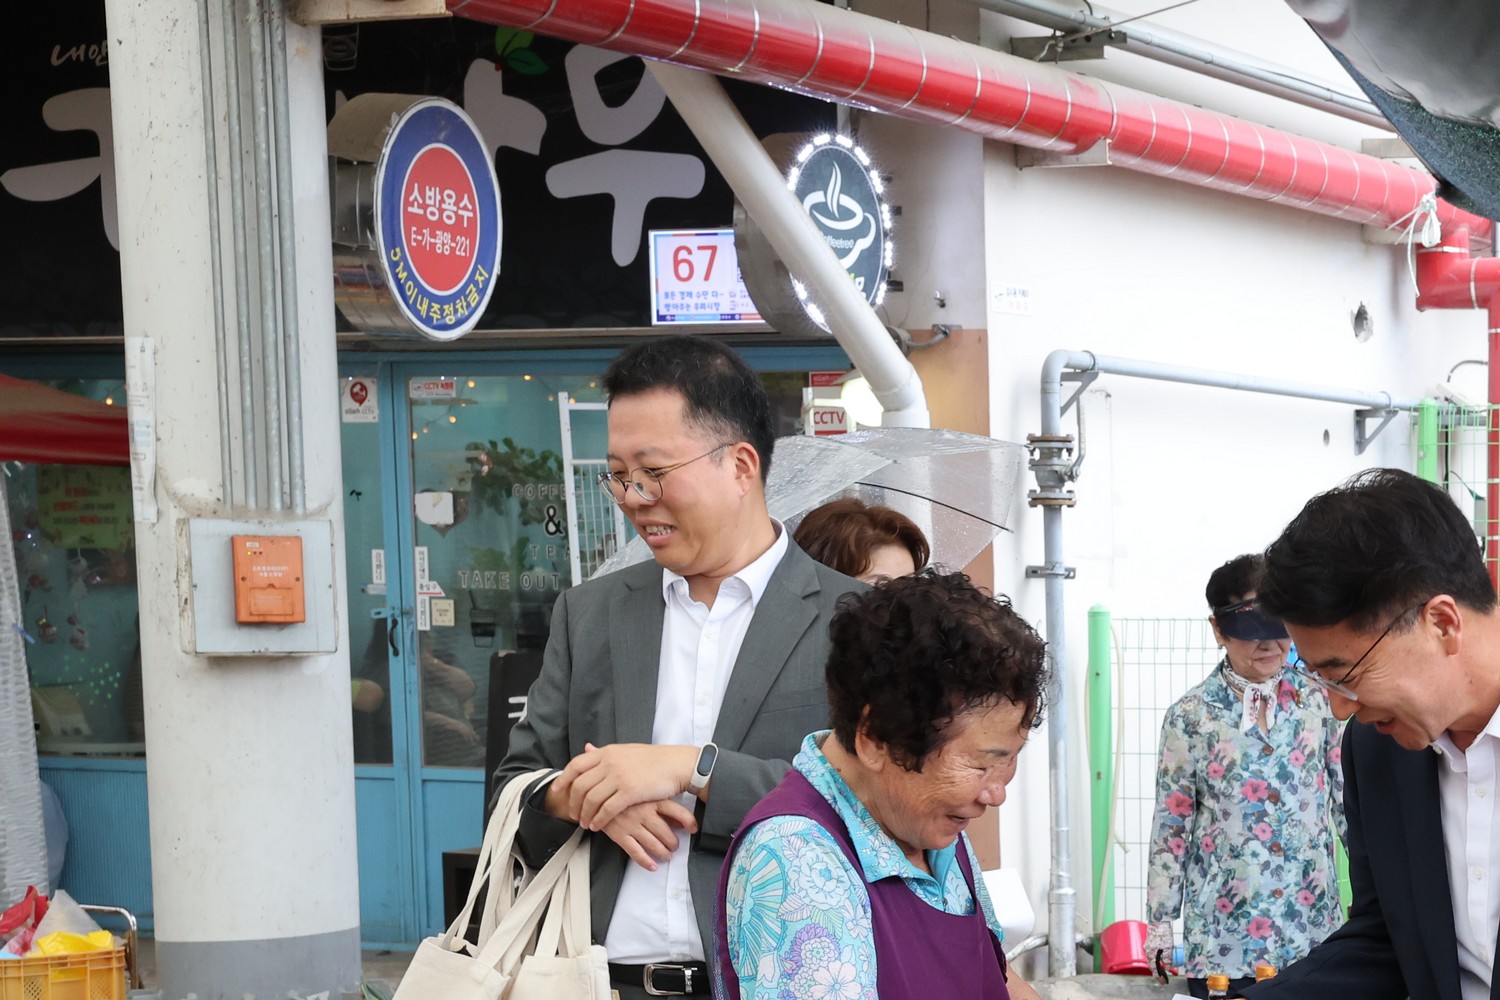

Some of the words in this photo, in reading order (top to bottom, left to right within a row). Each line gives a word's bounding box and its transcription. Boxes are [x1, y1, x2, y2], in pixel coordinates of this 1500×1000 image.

[407, 182, 473, 228] 소방용수
[411, 226, 470, 257] E-가-광양-221
[673, 245, 718, 282] 67
[814, 411, 845, 424] CCTV
[544, 505, 564, 536] &
[458, 570, 510, 590] TAKE
[520, 572, 561, 590] OUT
